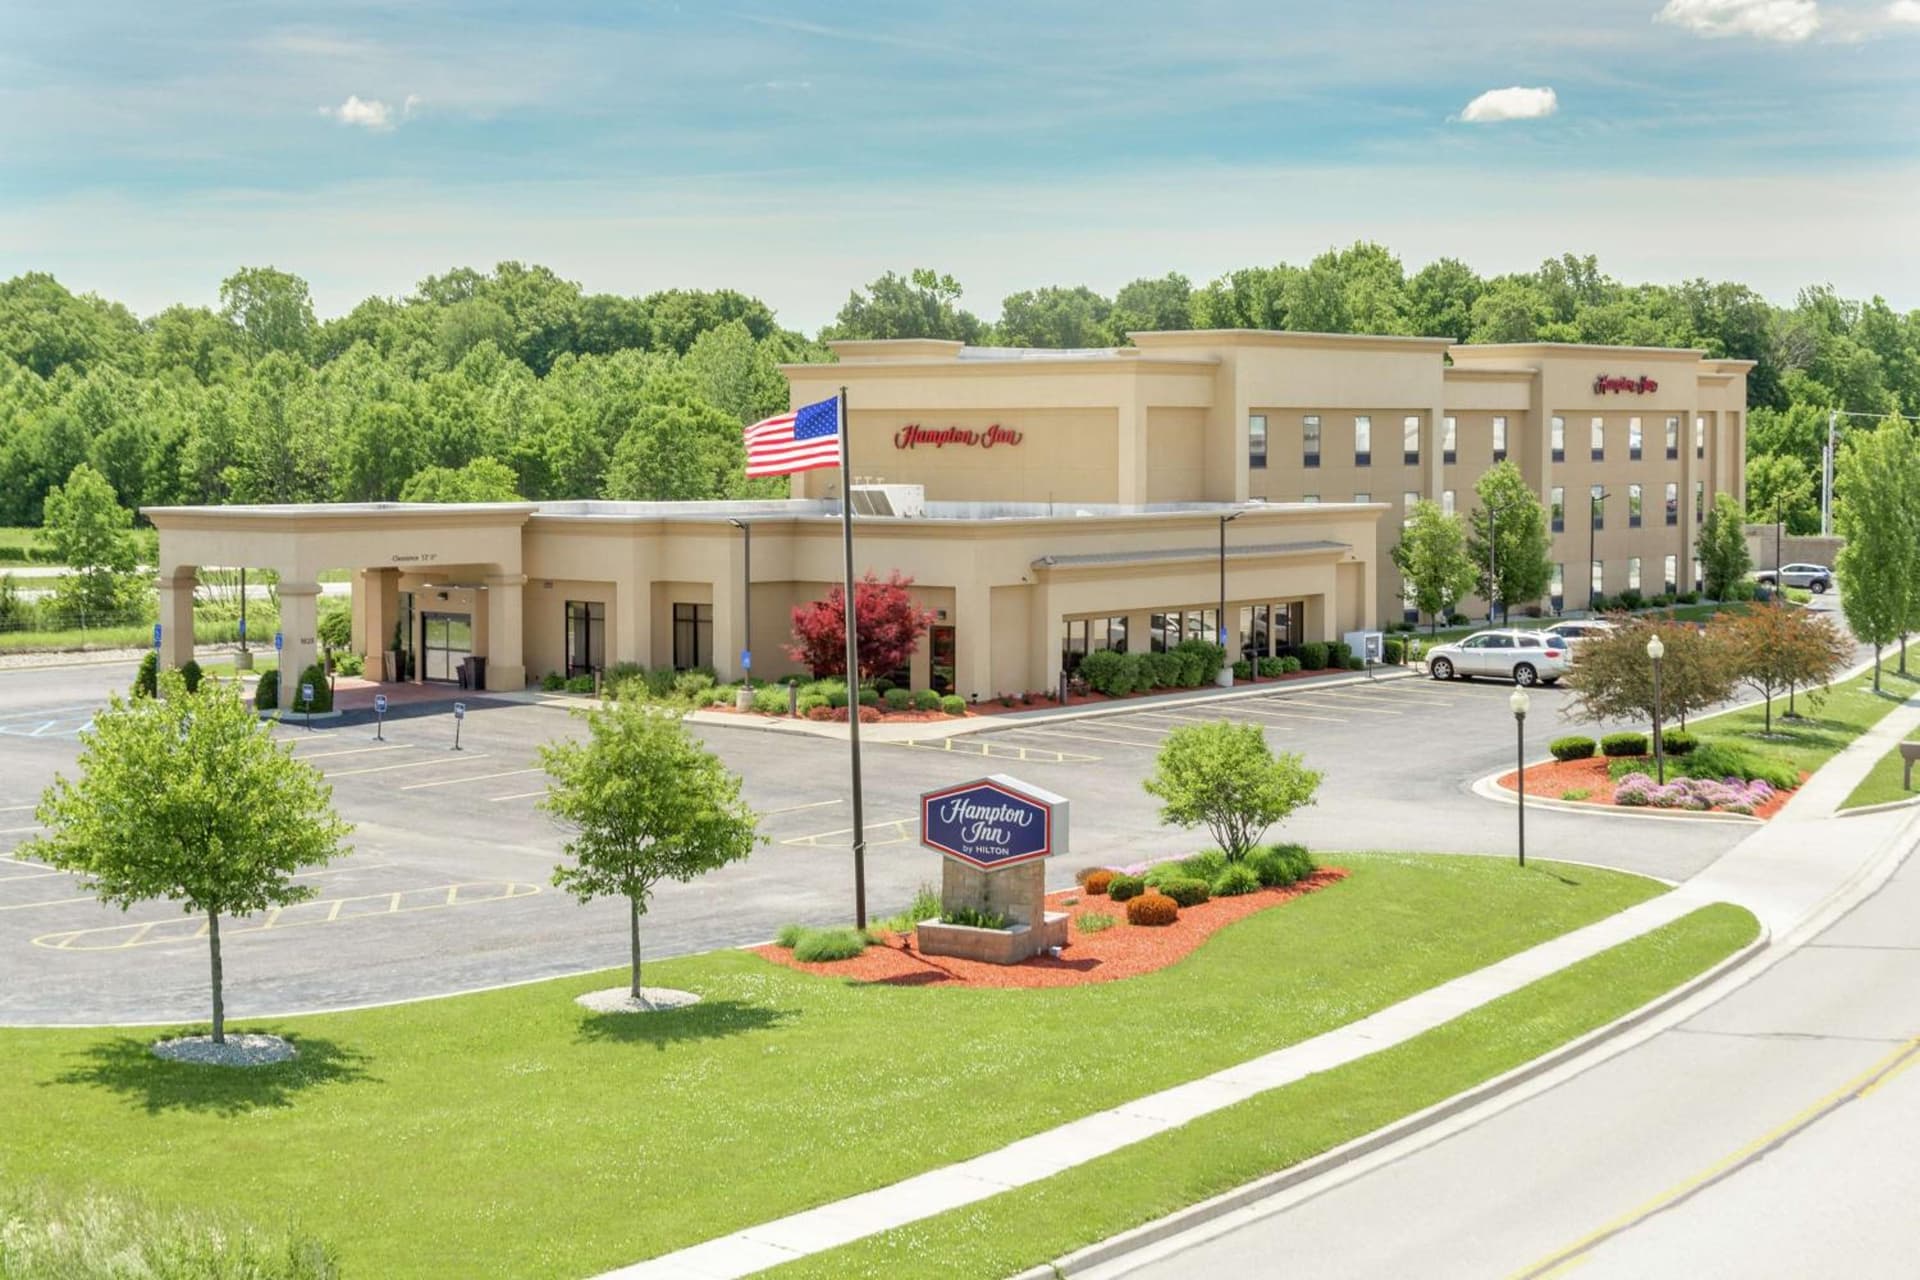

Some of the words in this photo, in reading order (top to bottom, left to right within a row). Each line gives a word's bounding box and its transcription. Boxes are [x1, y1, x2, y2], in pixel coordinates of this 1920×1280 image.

[1593, 374, 1635, 395] Hampton
[1636, 375, 1658, 395] Inn
[894, 423, 980, 449] Hampton
[980, 424, 1023, 449] Inn
[940, 798, 1033, 827] Hampton
[961, 821, 1011, 845] Inn
[962, 844, 973, 854] by
[975, 845, 1010, 855] HILTON
